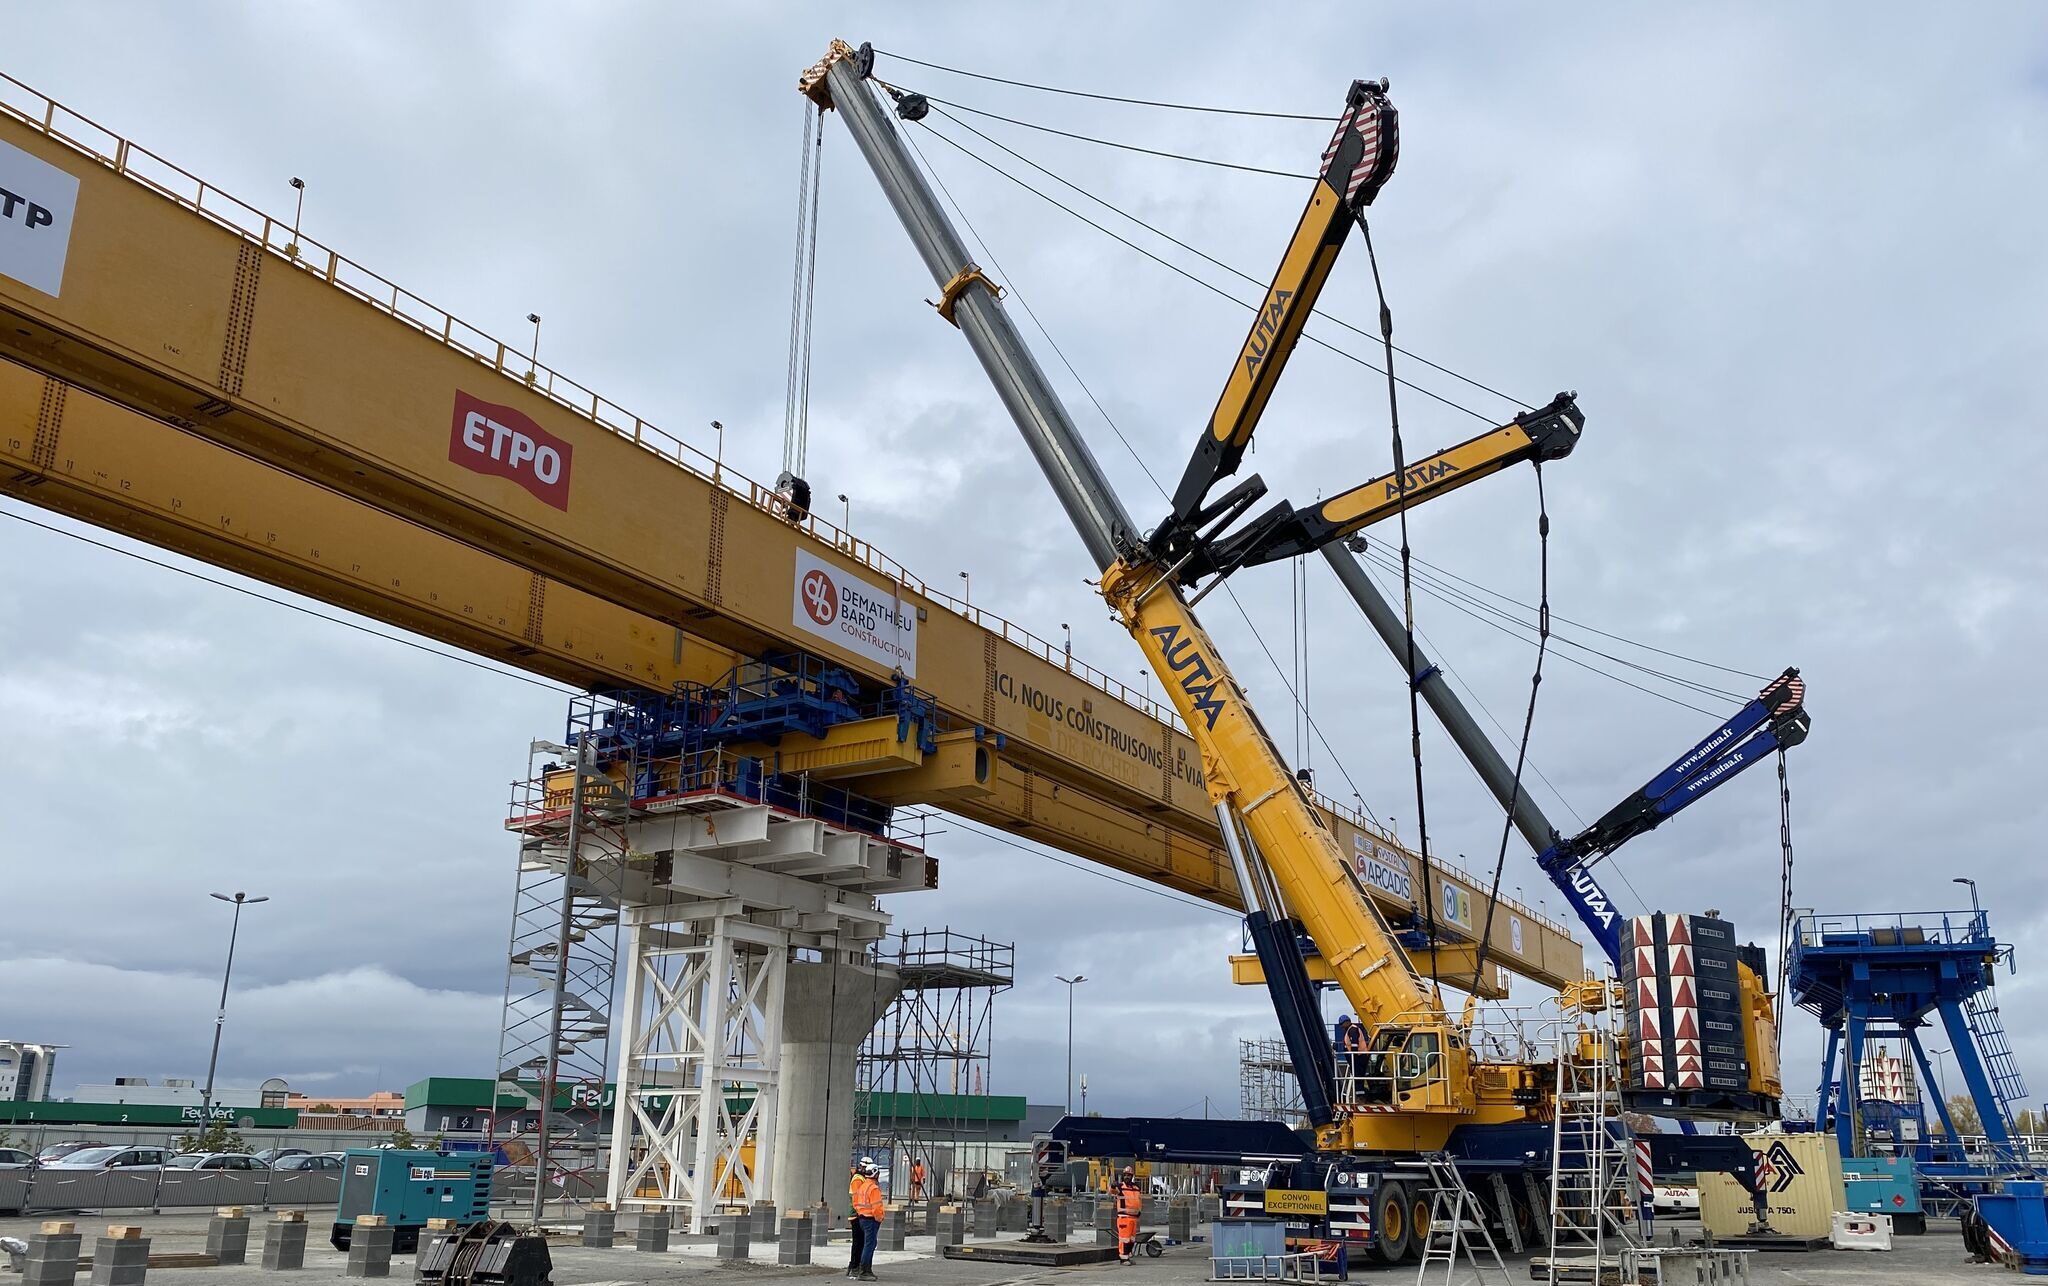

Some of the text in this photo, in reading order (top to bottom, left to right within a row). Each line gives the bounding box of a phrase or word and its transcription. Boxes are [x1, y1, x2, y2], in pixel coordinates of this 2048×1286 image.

[1246, 289, 1293, 382] AUTAA
[8, 437, 20, 449] 10
[463, 410, 561, 485] ETPO
[66, 459, 74, 470] 11
[119, 479, 131, 490] 12
[1385, 459, 1460, 500] AUTAA
[171, 498, 182, 509] 13
[220, 515, 231, 526] 14
[266, 532, 276, 542] 15
[310, 548, 320, 558] 16
[351, 564, 361, 573] 17
[391, 578, 400, 587] 18
[429, 591, 438, 601] 19
[463, 604, 473, 614] 20
[841, 604, 876, 631] BARD
[840, 621, 911, 661] CONSTRUCTION
[1149, 624, 1227, 733] AUTAA
[1022, 683, 1063, 722] NOUS
[1066, 706, 1163, 770] CONSTRUISONS
[1171, 757, 1183, 779] LE
[1675, 728, 1733, 773] www.autaa.fr
[1687, 753, 1744, 792] www.autaa.fr
[1368, 861, 1410, 900] ARCADIS
[1568, 868, 1615, 930] AUTAA
[121, 1114, 128, 1122] 2
[208, 1107, 235, 1119] Vert
[1281, 1193, 1310, 1201] CONVOI
[1268, 1201, 1324, 1211] EXCEPTIONNEL
[1777, 1206, 1796, 1214] 750t
